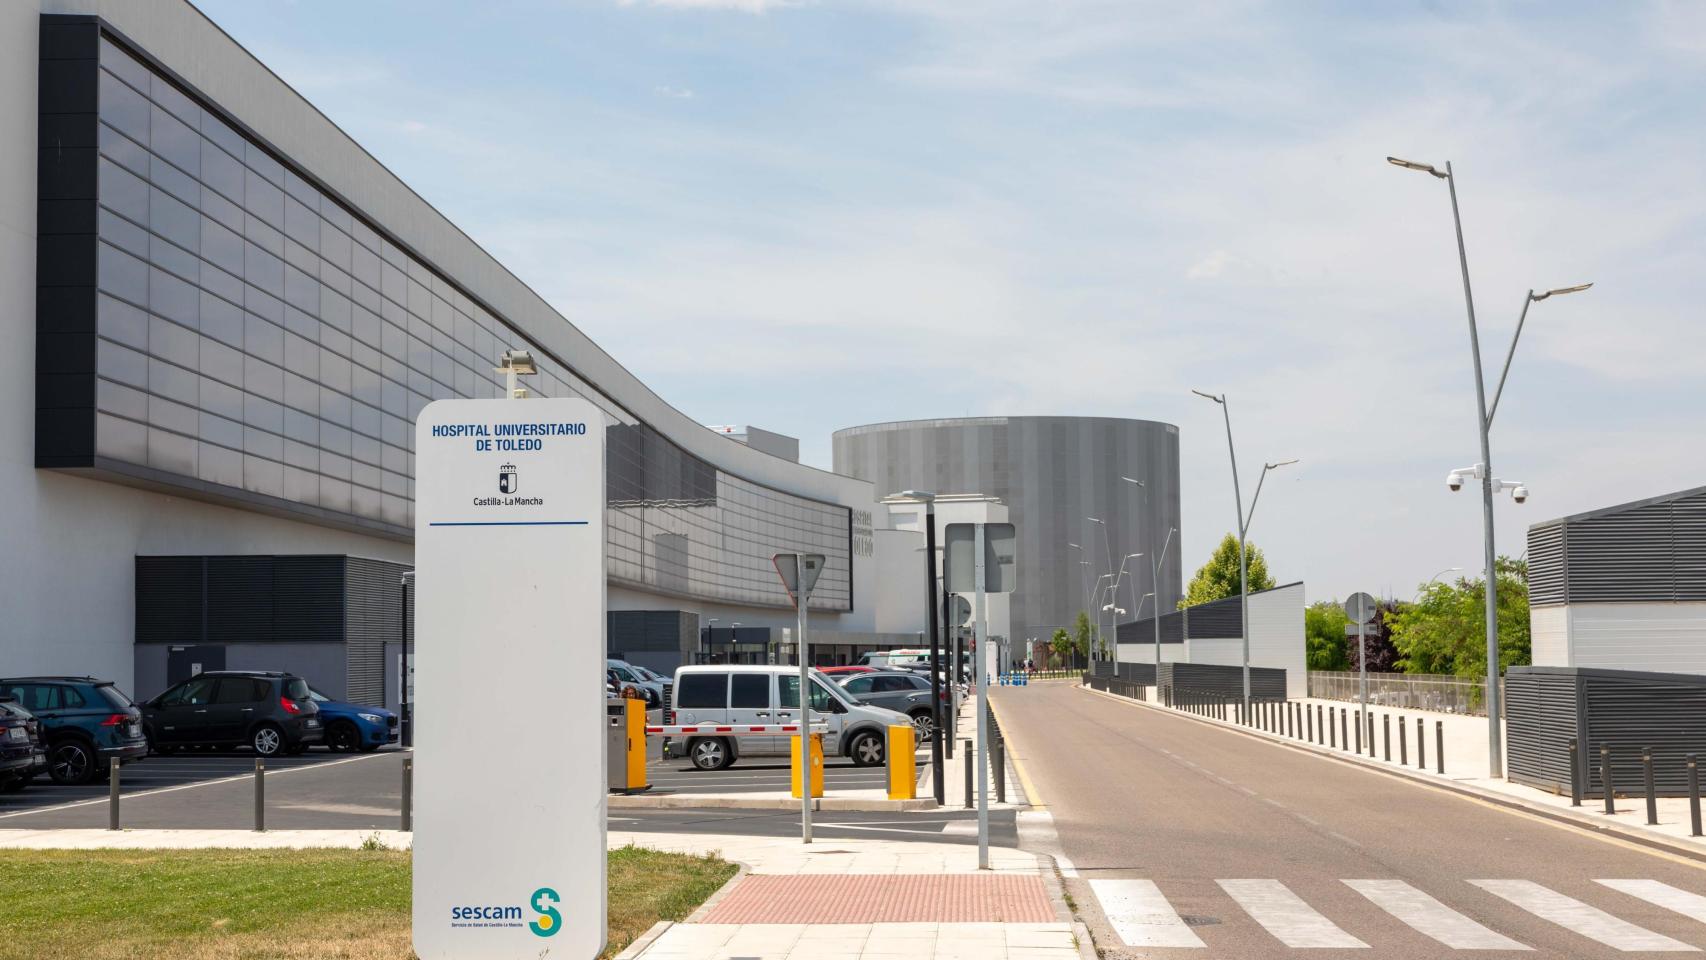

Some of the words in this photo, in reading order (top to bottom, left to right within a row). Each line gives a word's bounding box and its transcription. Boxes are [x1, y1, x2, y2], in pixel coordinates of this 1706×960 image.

[432, 425, 490, 437] HOSPITAL
[494, 423, 586, 436] UNIVERSITARIO
[476, 440, 492, 451] DE
[496, 438, 542, 451] TOLEDO
[515, 497, 543, 505] Mancha
[452, 906, 522, 919] sescam
